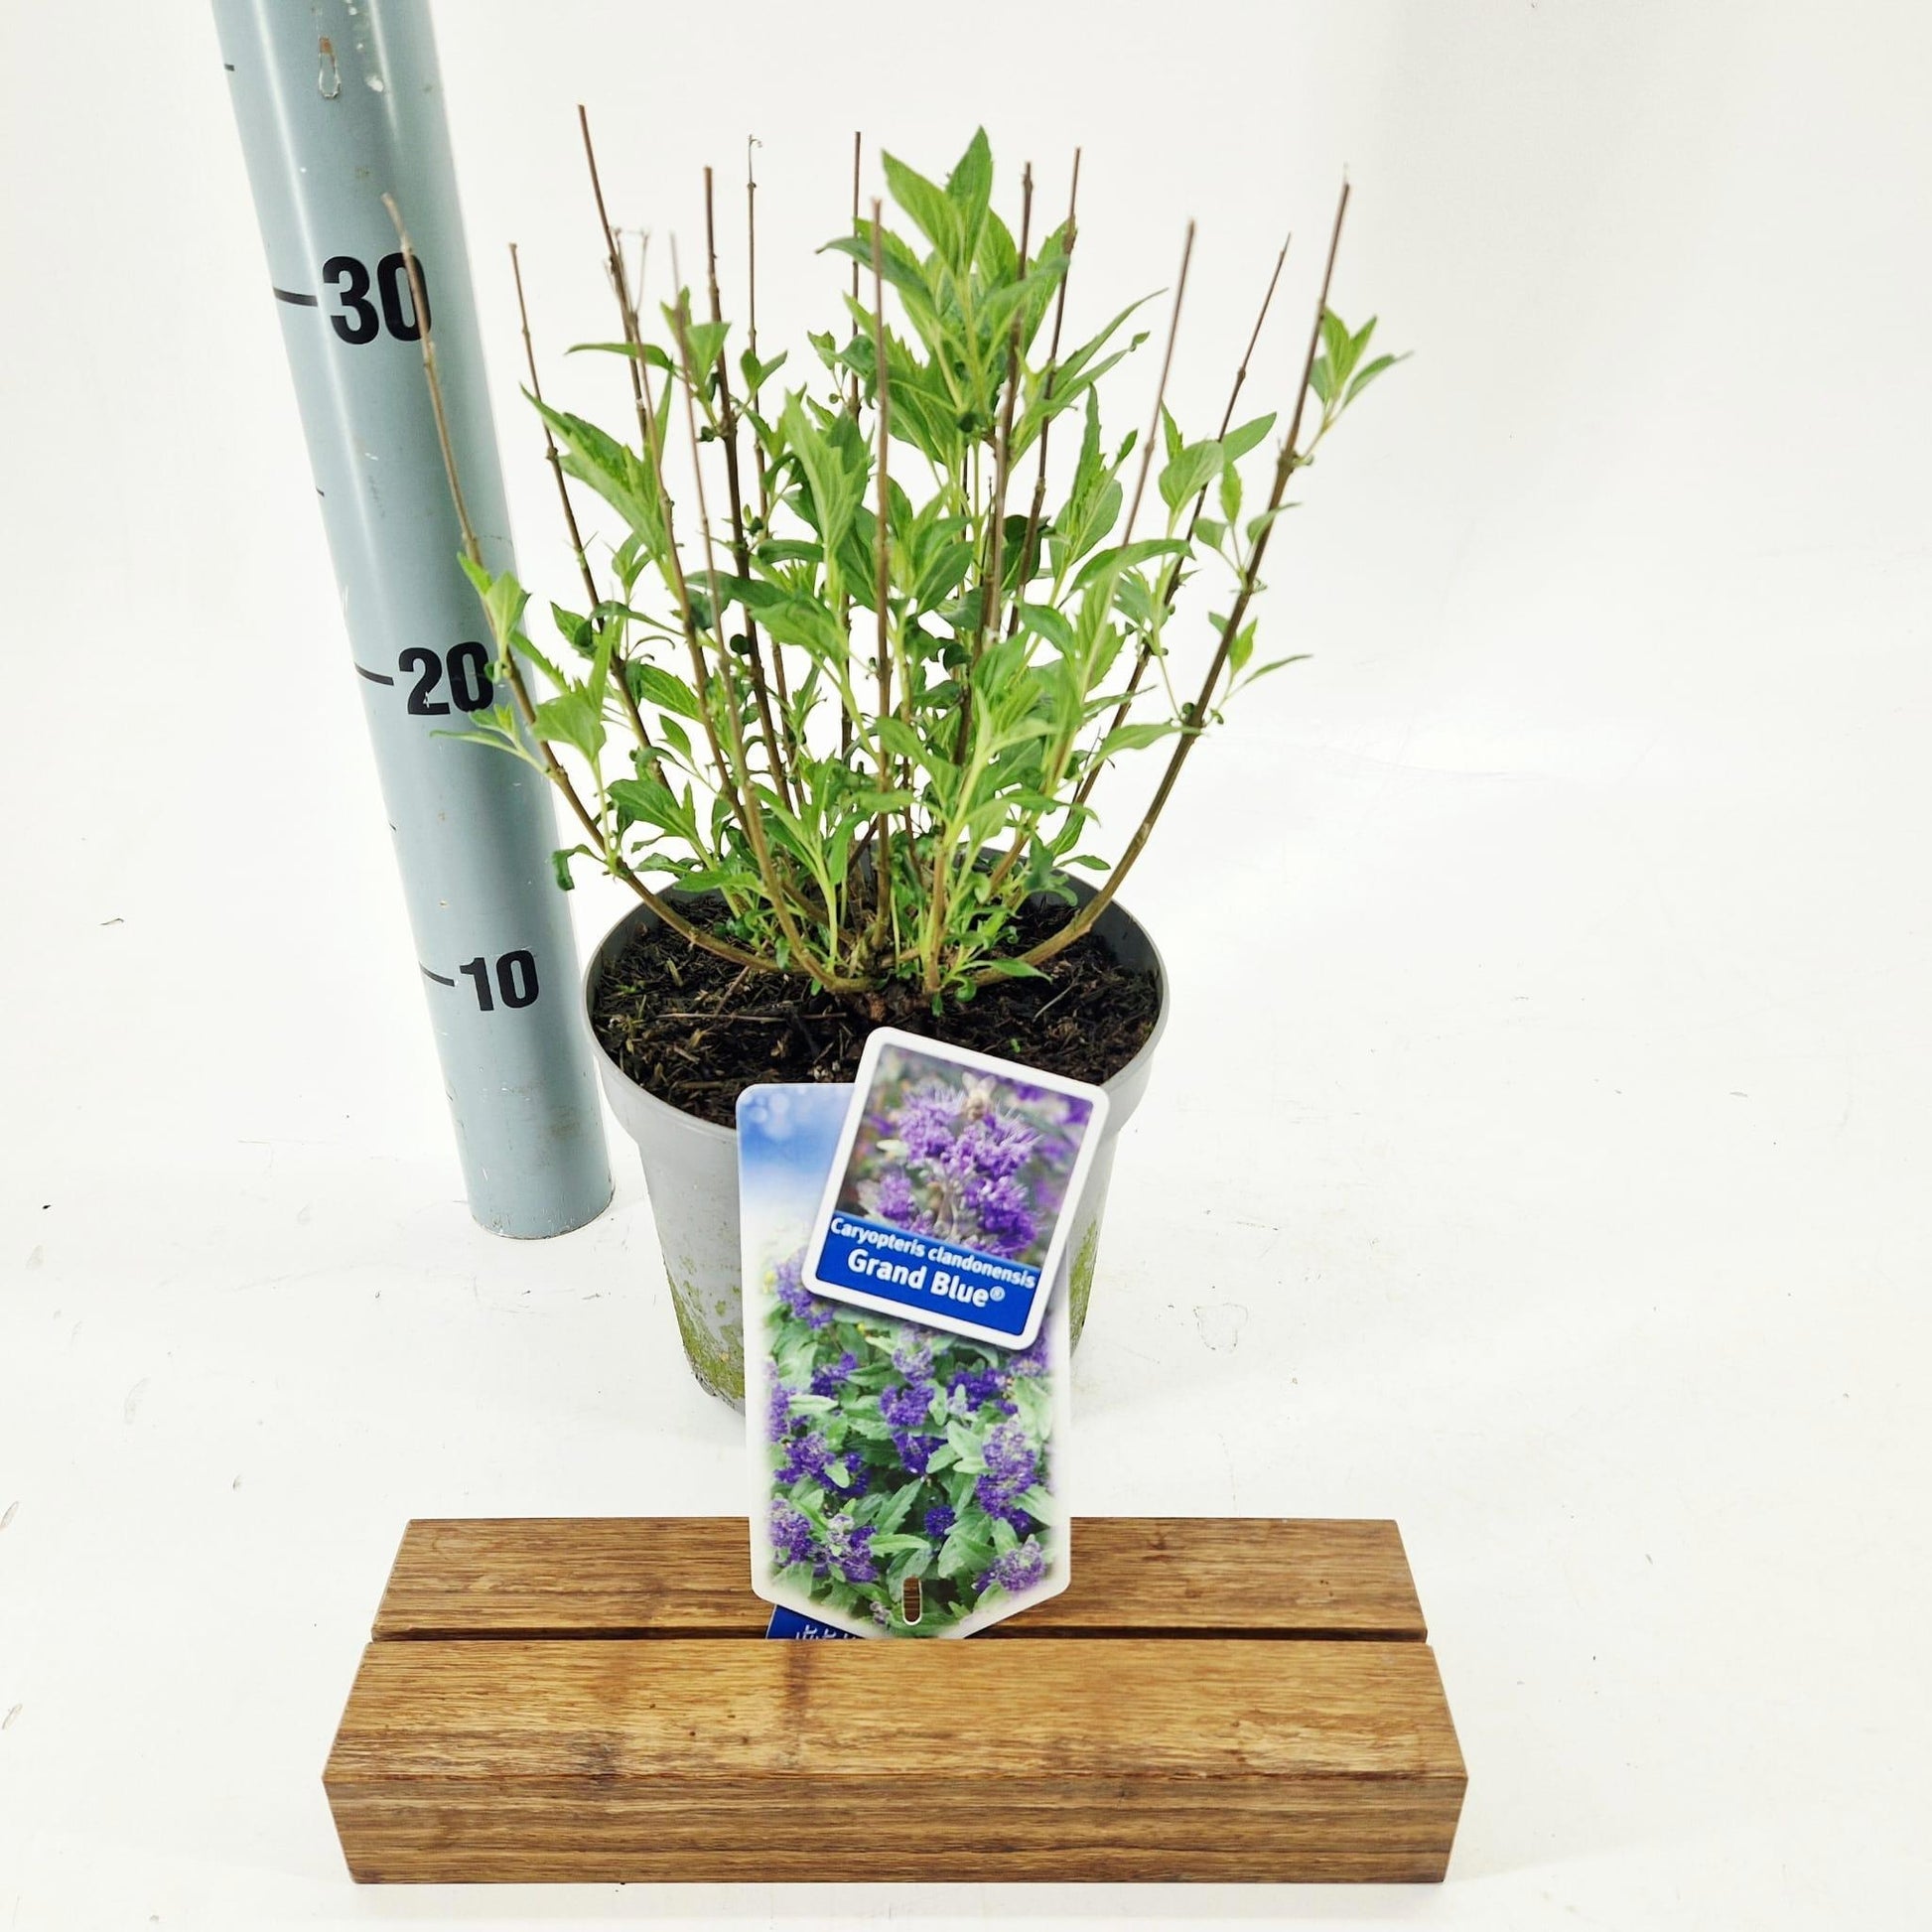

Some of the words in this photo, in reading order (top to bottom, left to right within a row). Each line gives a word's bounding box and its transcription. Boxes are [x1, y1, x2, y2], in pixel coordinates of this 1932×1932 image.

[322, 252, 432, 345] 30
[399, 641, 494, 715] 20
[460, 950, 539, 1011] 10
[831, 1217, 925, 1259] Caryopteris
[927, 1245, 1035, 1289] clandonensis
[847, 1248, 927, 1290] Grand
